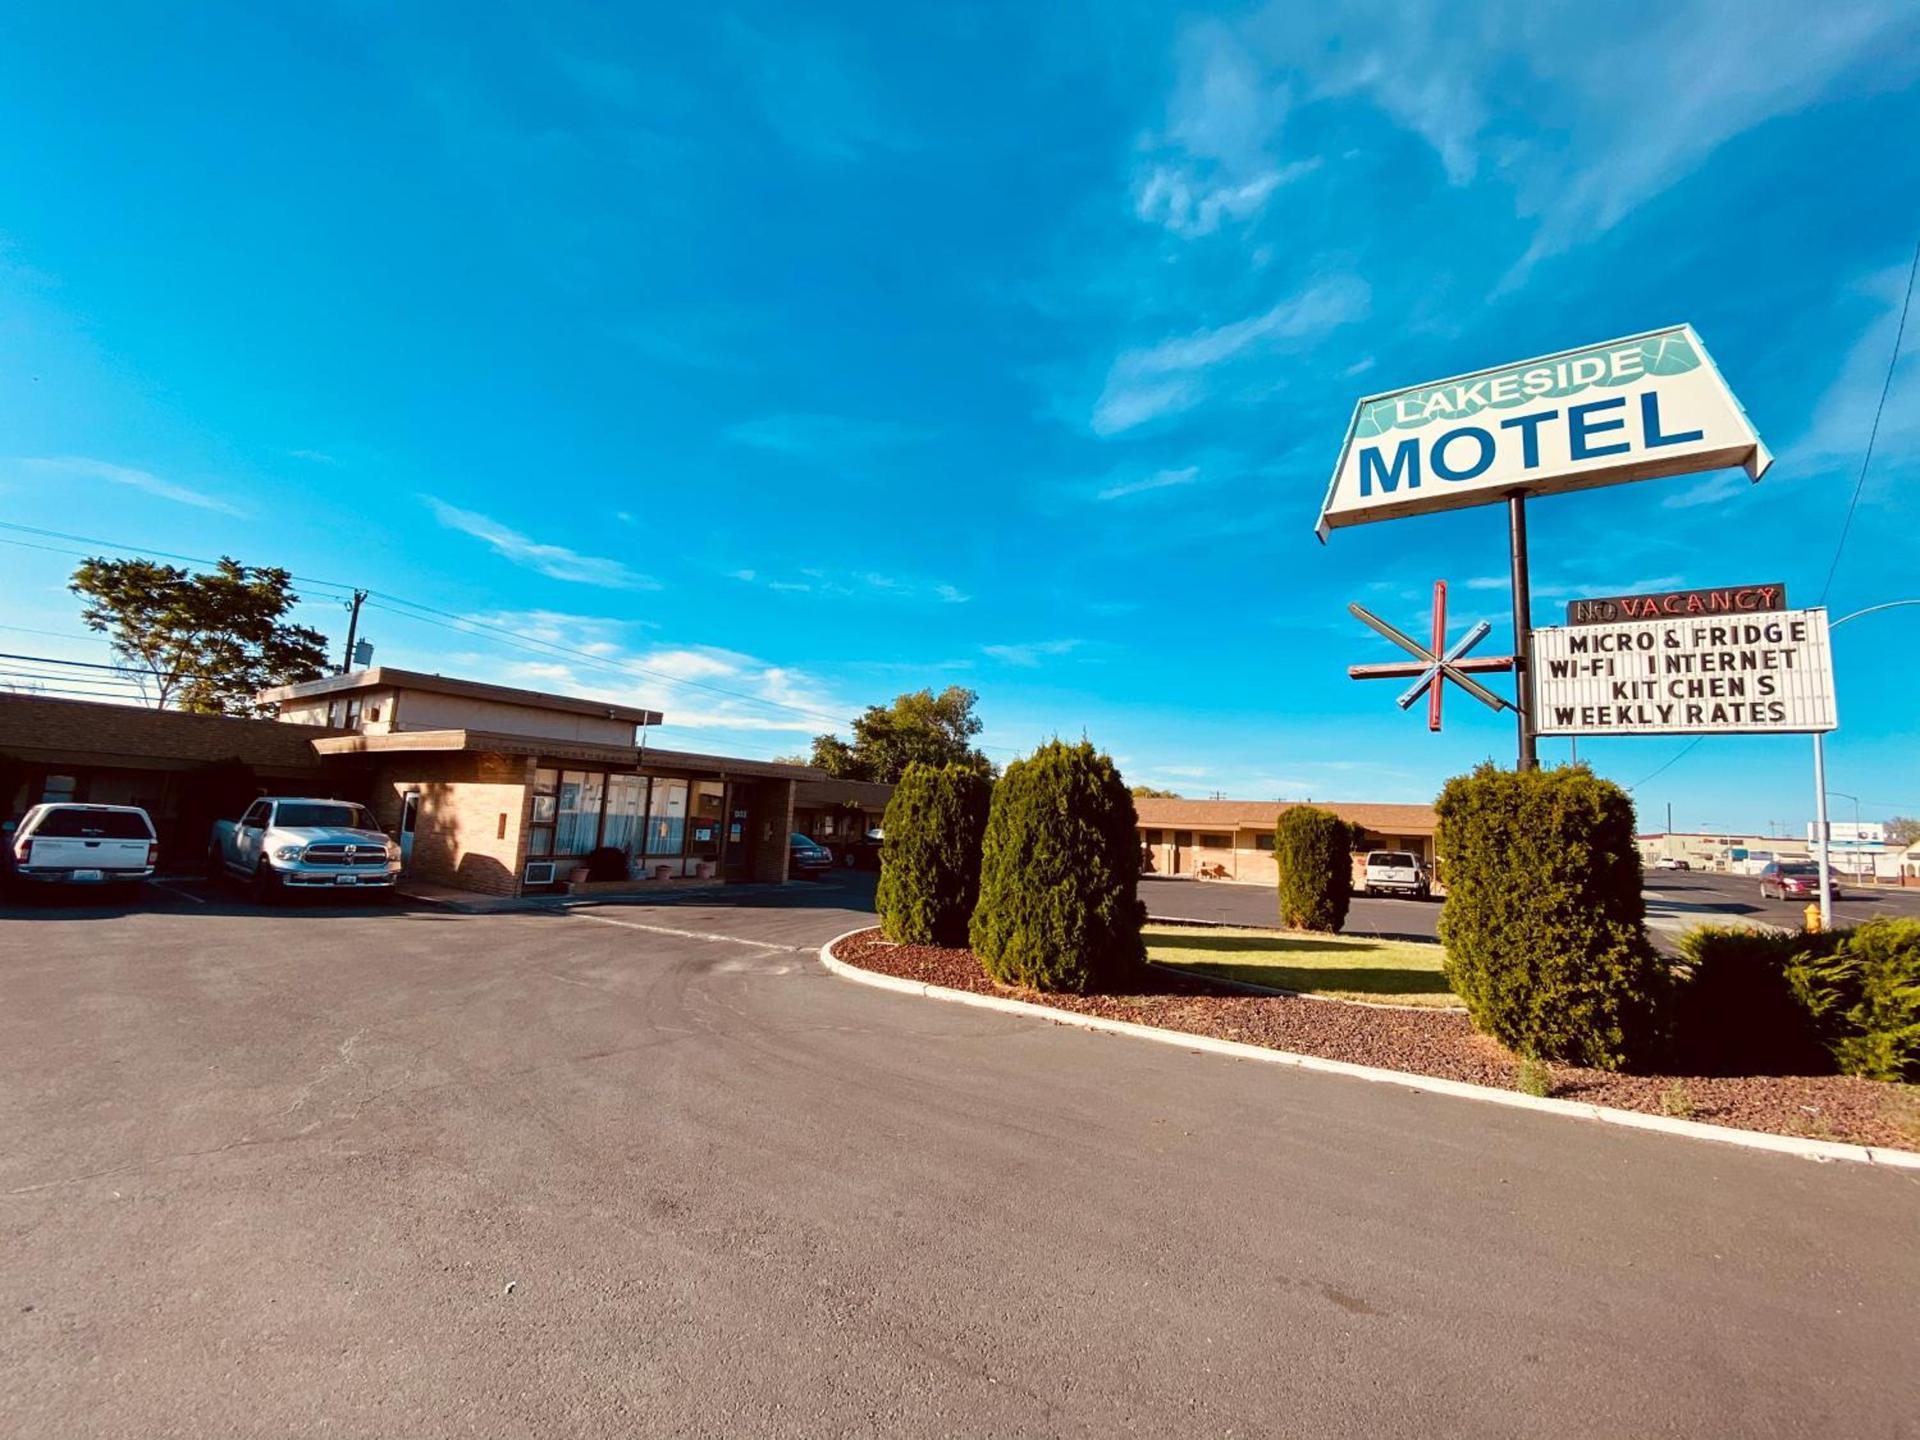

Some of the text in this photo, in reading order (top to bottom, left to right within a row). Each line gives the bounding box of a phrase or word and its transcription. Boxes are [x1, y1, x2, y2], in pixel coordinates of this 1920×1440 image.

[1395, 347, 1644, 423] LAKESIDE
[1359, 391, 1704, 497] MOTEL
[1576, 587, 1775, 620] NO VACANCY
[1569, 622, 1806, 654] MICRO & FRIDGE
[1550, 648, 1797, 678] WI-FI INTERNET
[1612, 675, 1775, 700] KITCHENS
[1555, 701, 1786, 725] WEEKLY RATES
